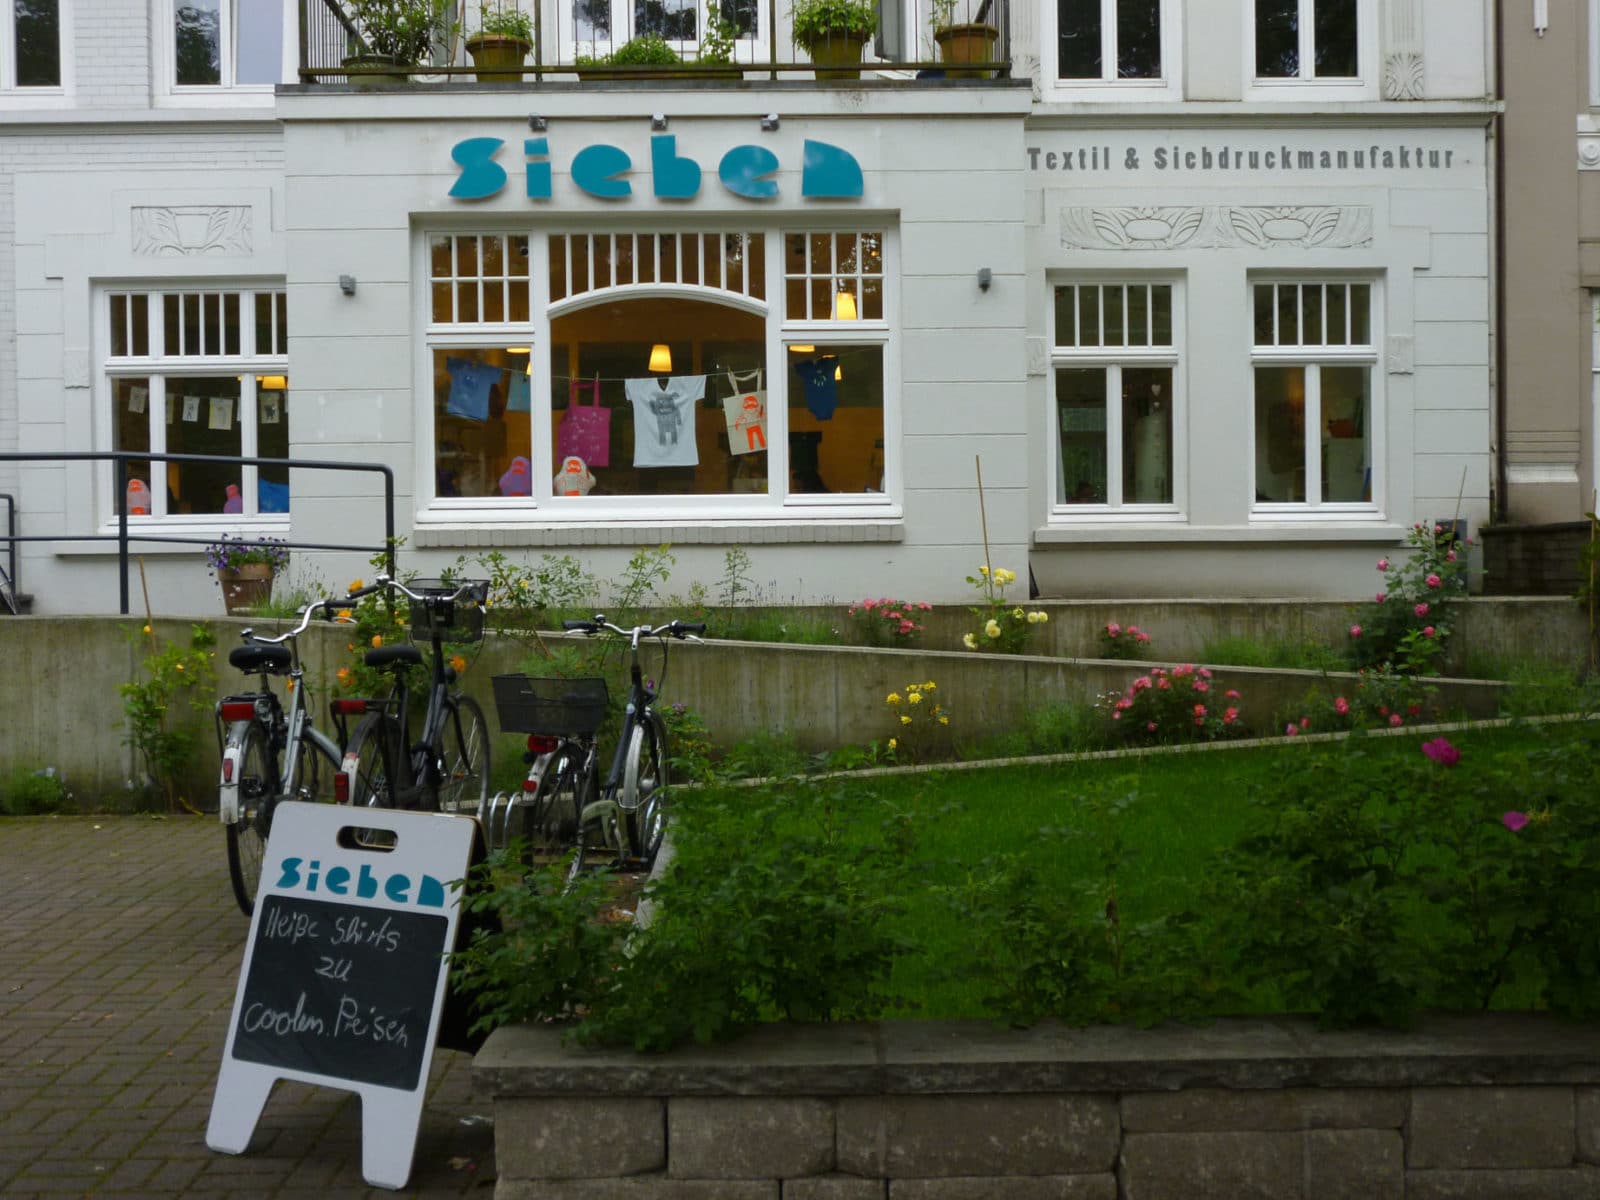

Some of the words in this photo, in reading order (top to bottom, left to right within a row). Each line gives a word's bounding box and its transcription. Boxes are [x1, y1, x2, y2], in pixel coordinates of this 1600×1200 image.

[447, 134, 865, 200] Sieben
[1027, 147, 1111, 171] Textil
[1124, 147, 1140, 170] &
[1154, 145, 1454, 170] Siebdruckmanufaktur
[276, 857, 446, 909] Sieben
[330, 915, 401, 952] Shirts
